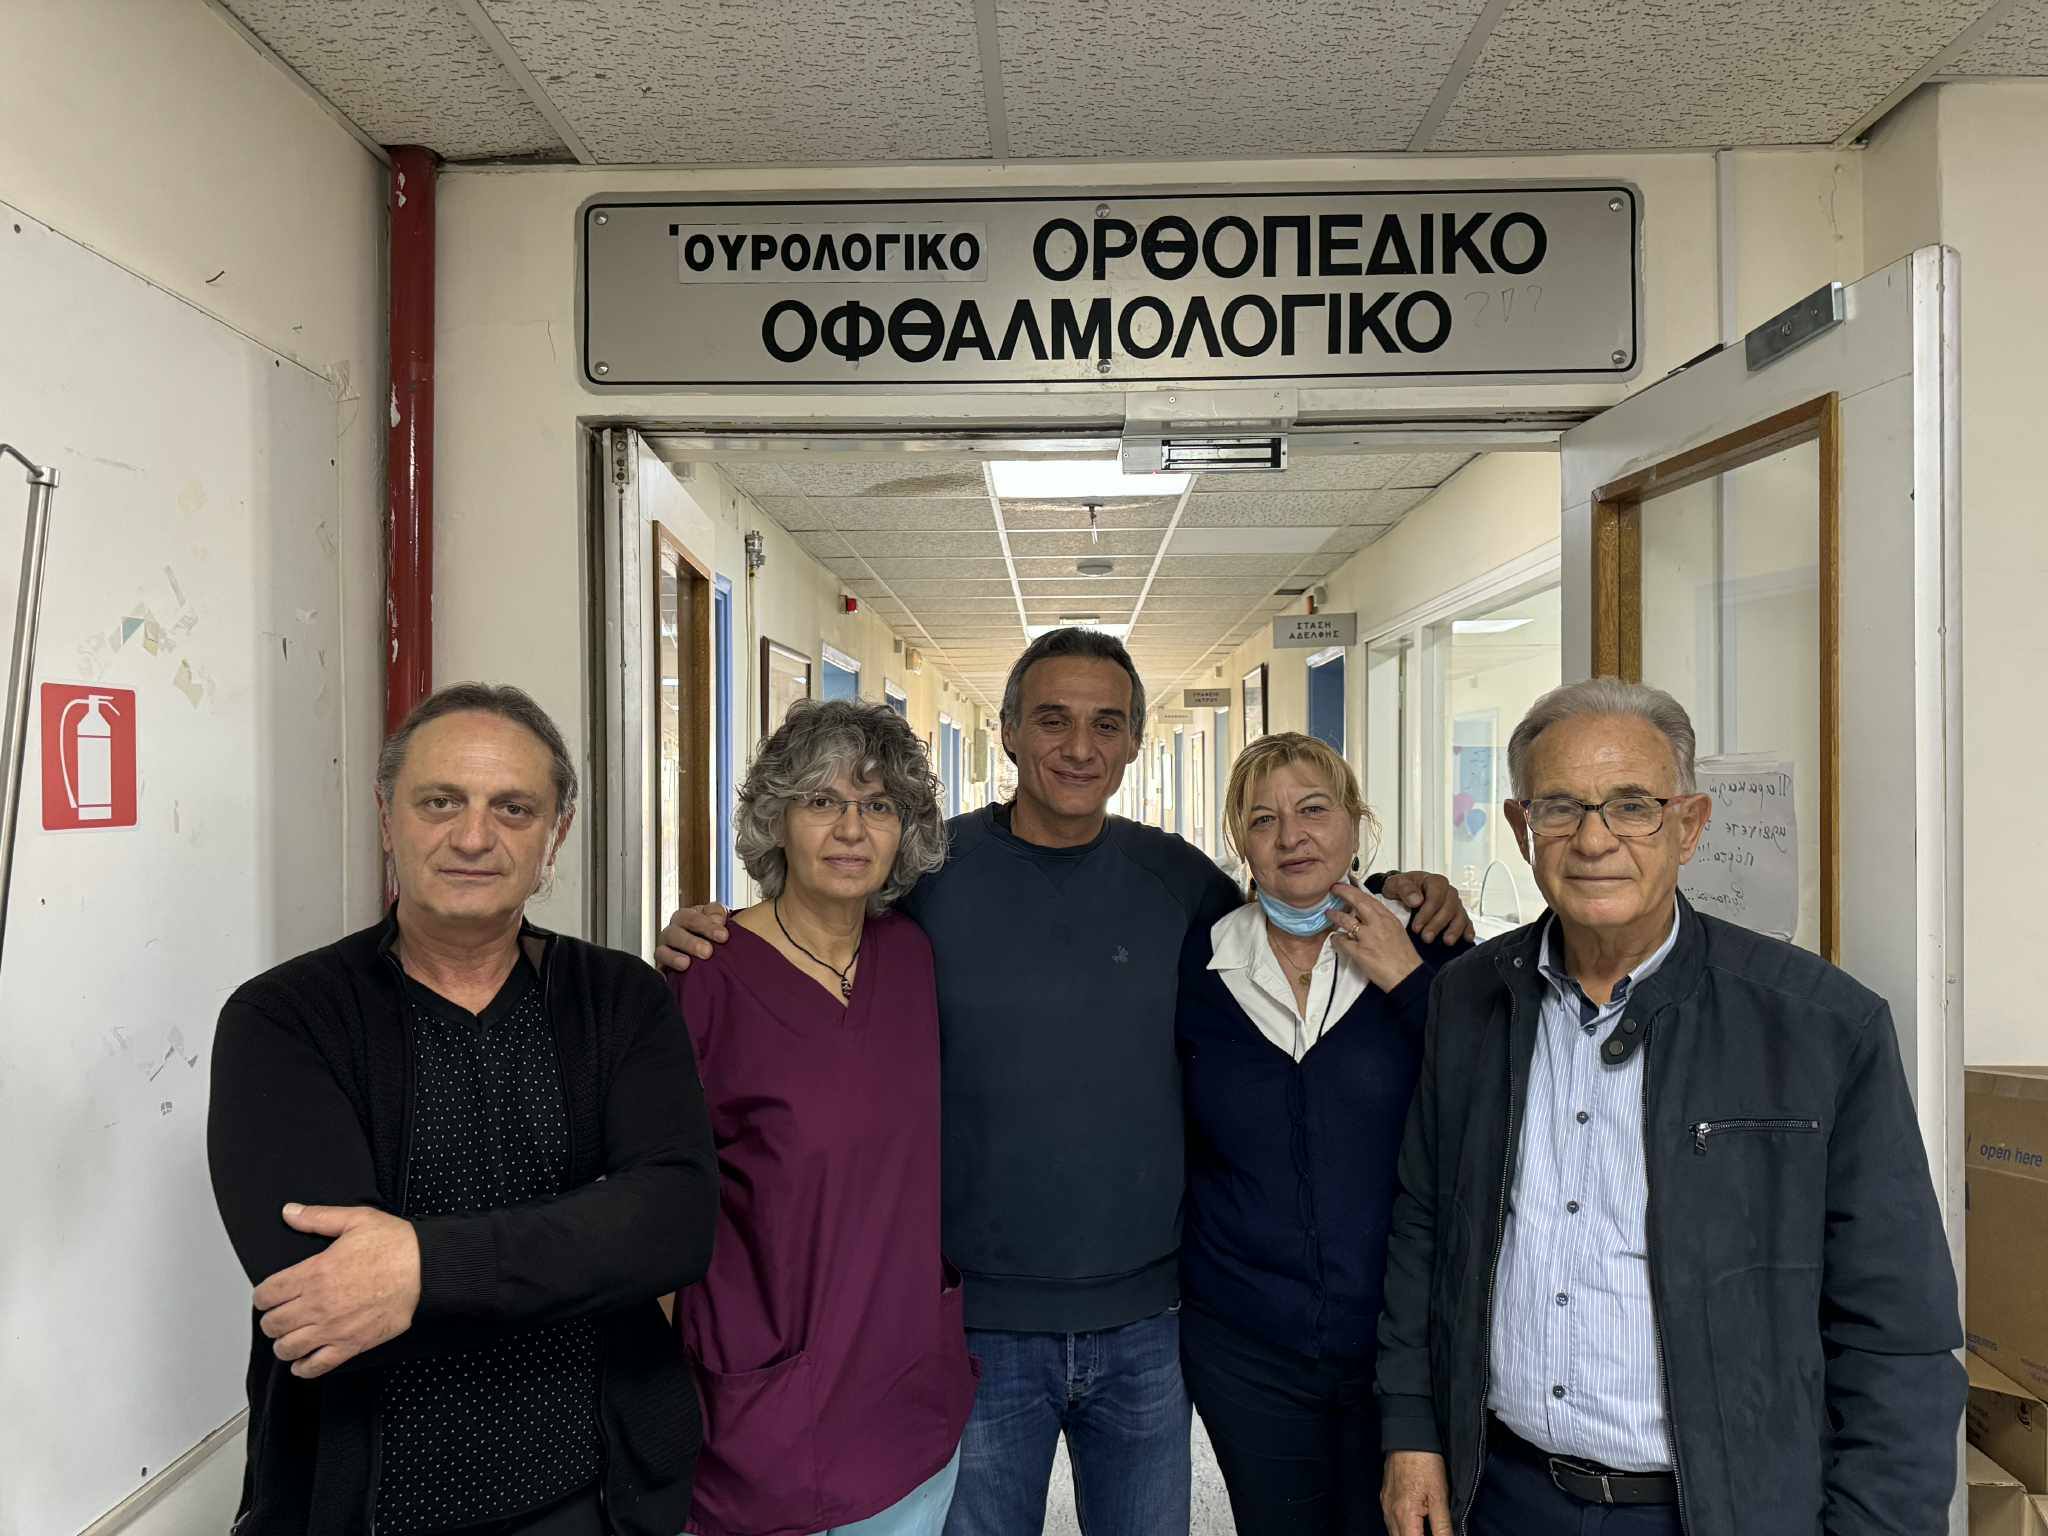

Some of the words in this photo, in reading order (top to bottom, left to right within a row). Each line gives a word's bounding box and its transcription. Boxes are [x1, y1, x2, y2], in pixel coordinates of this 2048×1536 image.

[684, 232, 980, 272] ΟΥΡΟΛΟΓΙΚΟ
[1032, 211, 1548, 282] ΟΡΘΟΠΕΔΙΚΟ
[761, 290, 1452, 363] ΟΦΘΑΛΜΟΛΟΓΙΚΟ
[1288, 630, 1340, 640] ΑΔΕΛΦΗΣ
[1296, 621, 1332, 631] ΣΤΑΣΗ
[1979, 1143, 2011, 1160] open
[2015, 1148, 2043, 1167] here
